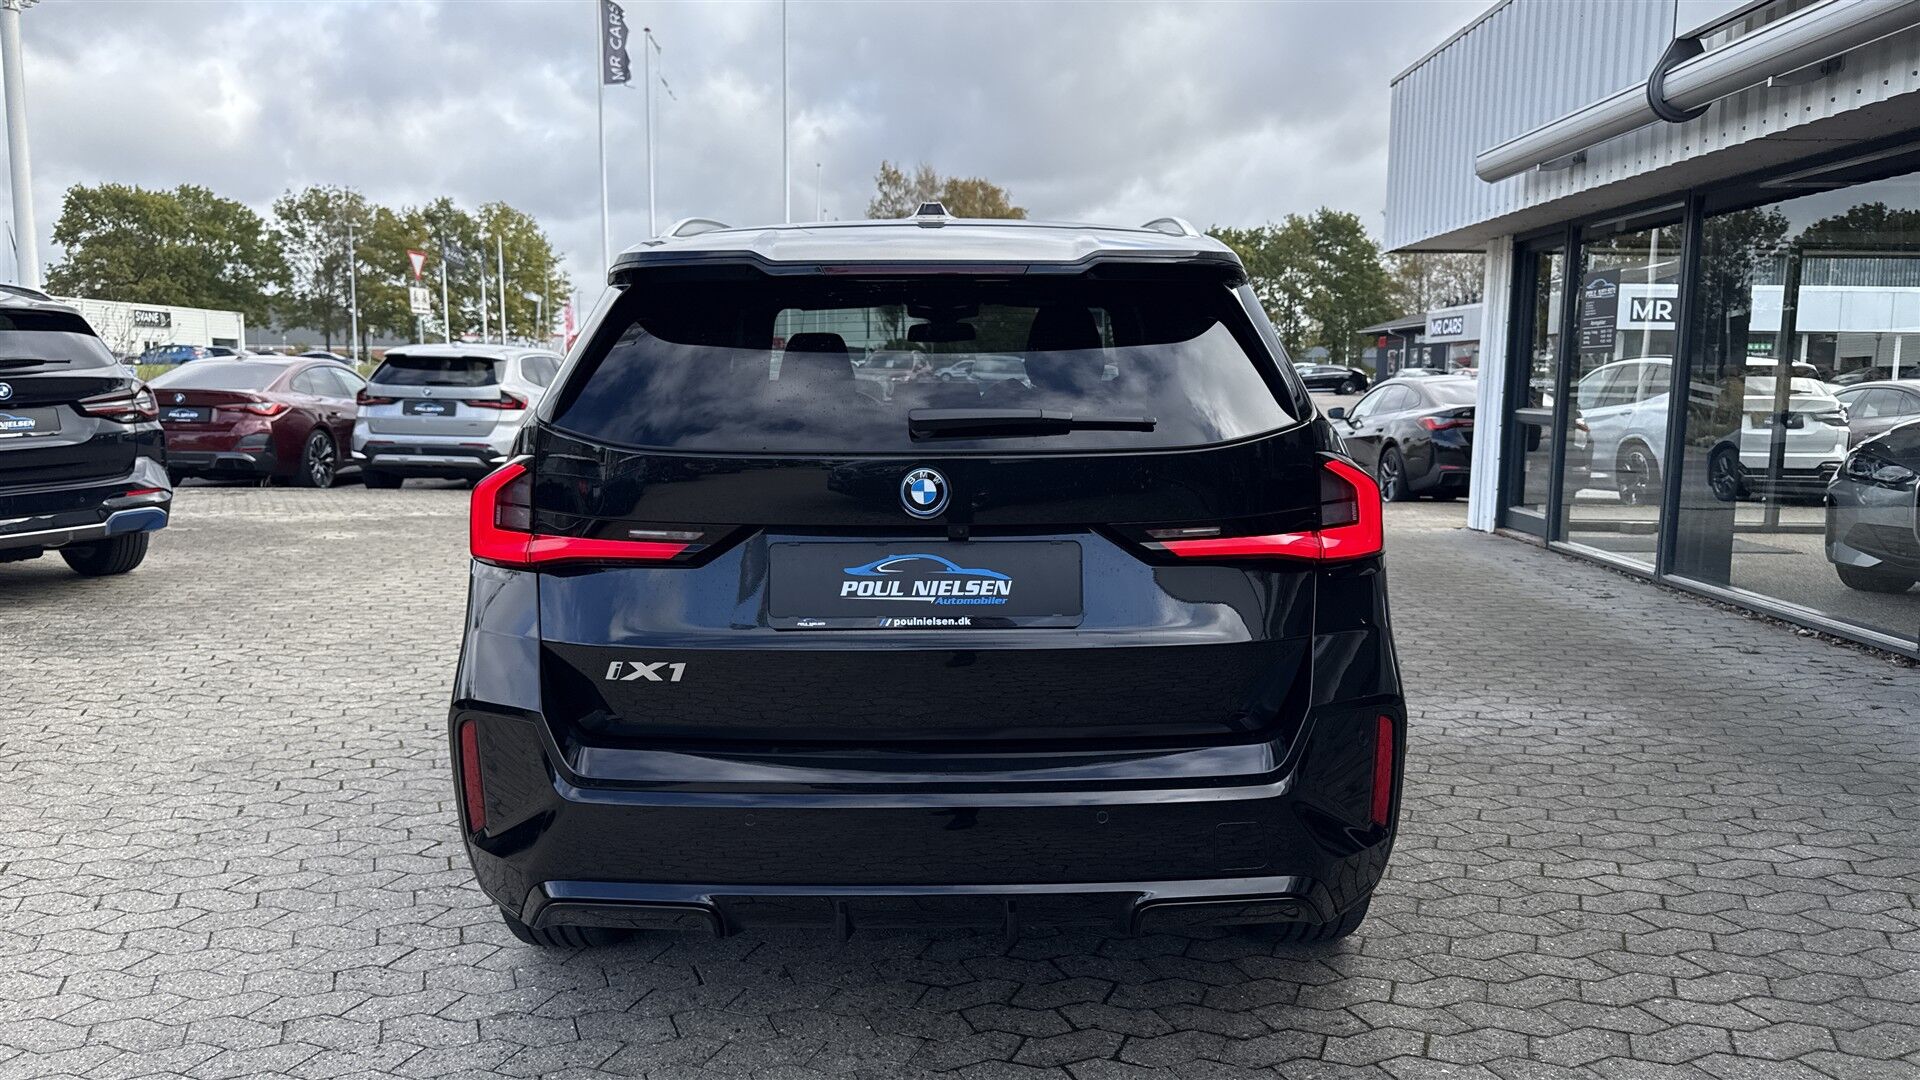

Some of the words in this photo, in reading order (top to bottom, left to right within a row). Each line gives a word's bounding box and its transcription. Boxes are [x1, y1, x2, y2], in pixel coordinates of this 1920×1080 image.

[608, 3, 622, 50] CARS
[610, 56, 625, 80] MR
[135, 310, 160, 323] SVANE
[1632, 299, 1673, 320] MR
[1431, 320, 1442, 334] MR
[1443, 318, 1463, 334] CARS
[907, 471, 942, 485] BMW
[840, 580, 904, 597] POUL
[911, 580, 1013, 596] NIELSEN
[935, 597, 1008, 605] Automobiler
[893, 617, 972, 627] poulnielsen.dk
[605, 661, 687, 682] iX1
